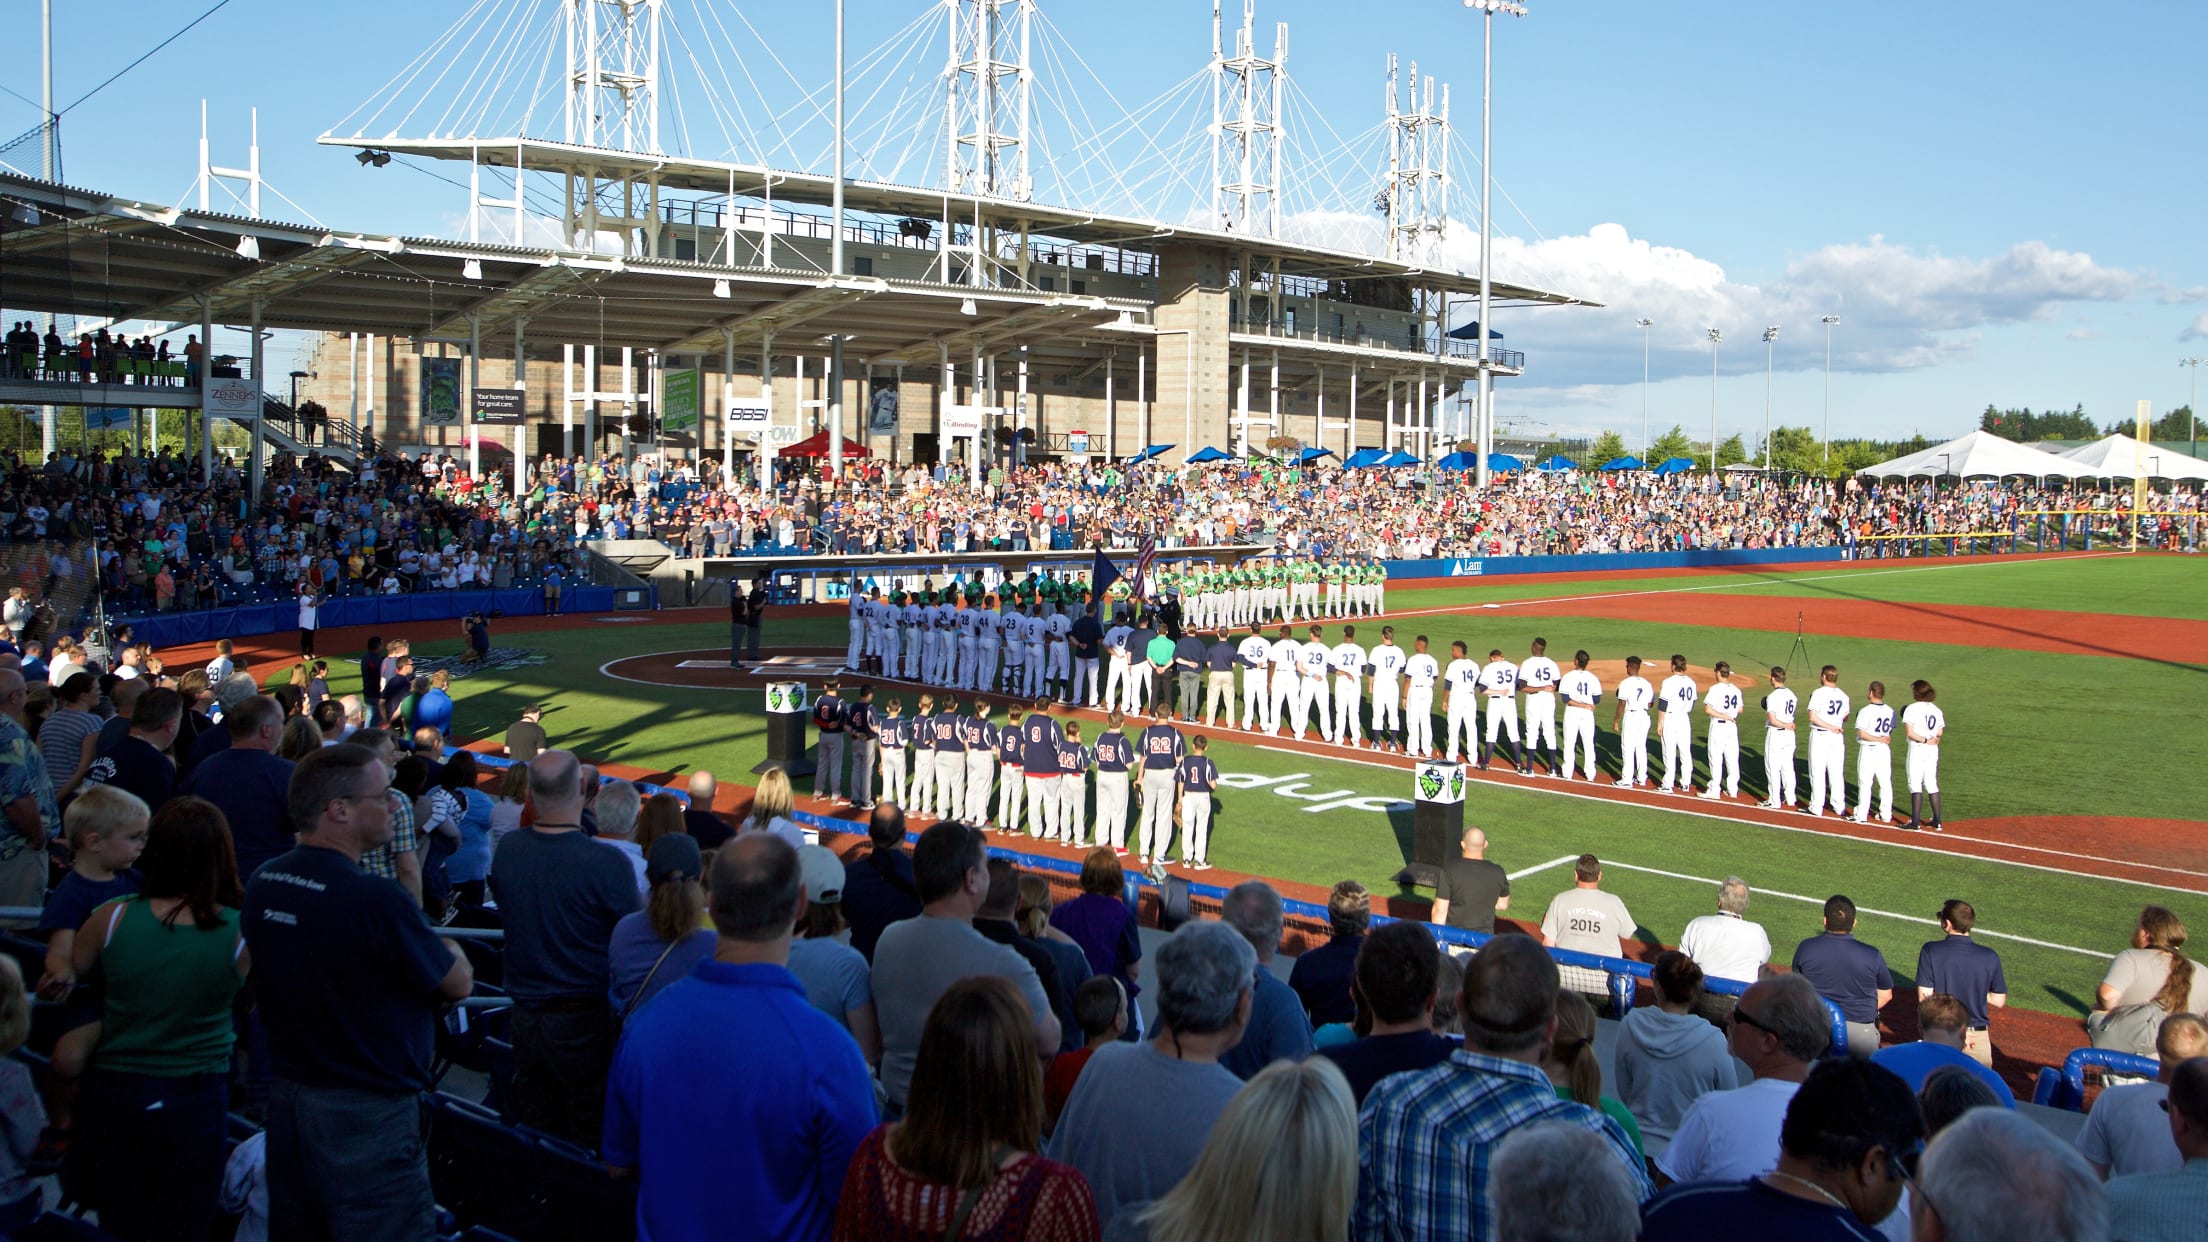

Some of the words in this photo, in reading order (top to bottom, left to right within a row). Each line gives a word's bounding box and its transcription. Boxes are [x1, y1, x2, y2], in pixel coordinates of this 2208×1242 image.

[730, 408, 768, 420] BBSI
[1464, 559, 1483, 570] Lam
[866, 607, 874, 617] 22
[961, 614, 970, 626] 28
[979, 617, 989, 627] 44
[1006, 618, 1016, 630] 23
[1053, 621, 1058, 632] 3
[1029, 624, 1034, 635] 5
[1117, 635, 1124, 646] 8
[1249, 645, 1263, 658] 36
[1286, 649, 1295, 661] 11
[1308, 652, 1323, 664] 29
[1342, 653, 1356, 666] 27
[1385, 655, 1396, 668] 17
[1462, 669, 1474, 682] 14
[1497, 669, 1513, 684] 35
[1535, 667, 1550, 681] 45
[1576, 681, 1588, 696] 41
[1636, 688, 1643, 701] 7
[1678, 686, 1693, 701] 40
[1723, 694, 1738, 710] 34
[1785, 699, 1794, 714] 16
[1827, 700, 1843, 715] 37
[853, 711, 861, 726] 4
[1875, 718, 1890, 733] 26
[913, 723, 920, 739] 7
[937, 724, 952, 740] 10
[967, 726, 980, 743] 13
[1031, 726, 1041, 742] 9
[1006, 736, 1016, 751] 3
[1150, 736, 1171, 754] 22
[1058, 751, 1076, 769] 42
[1191, 766, 1199, 783] 1
[1570, 918, 1601, 934] 2015
